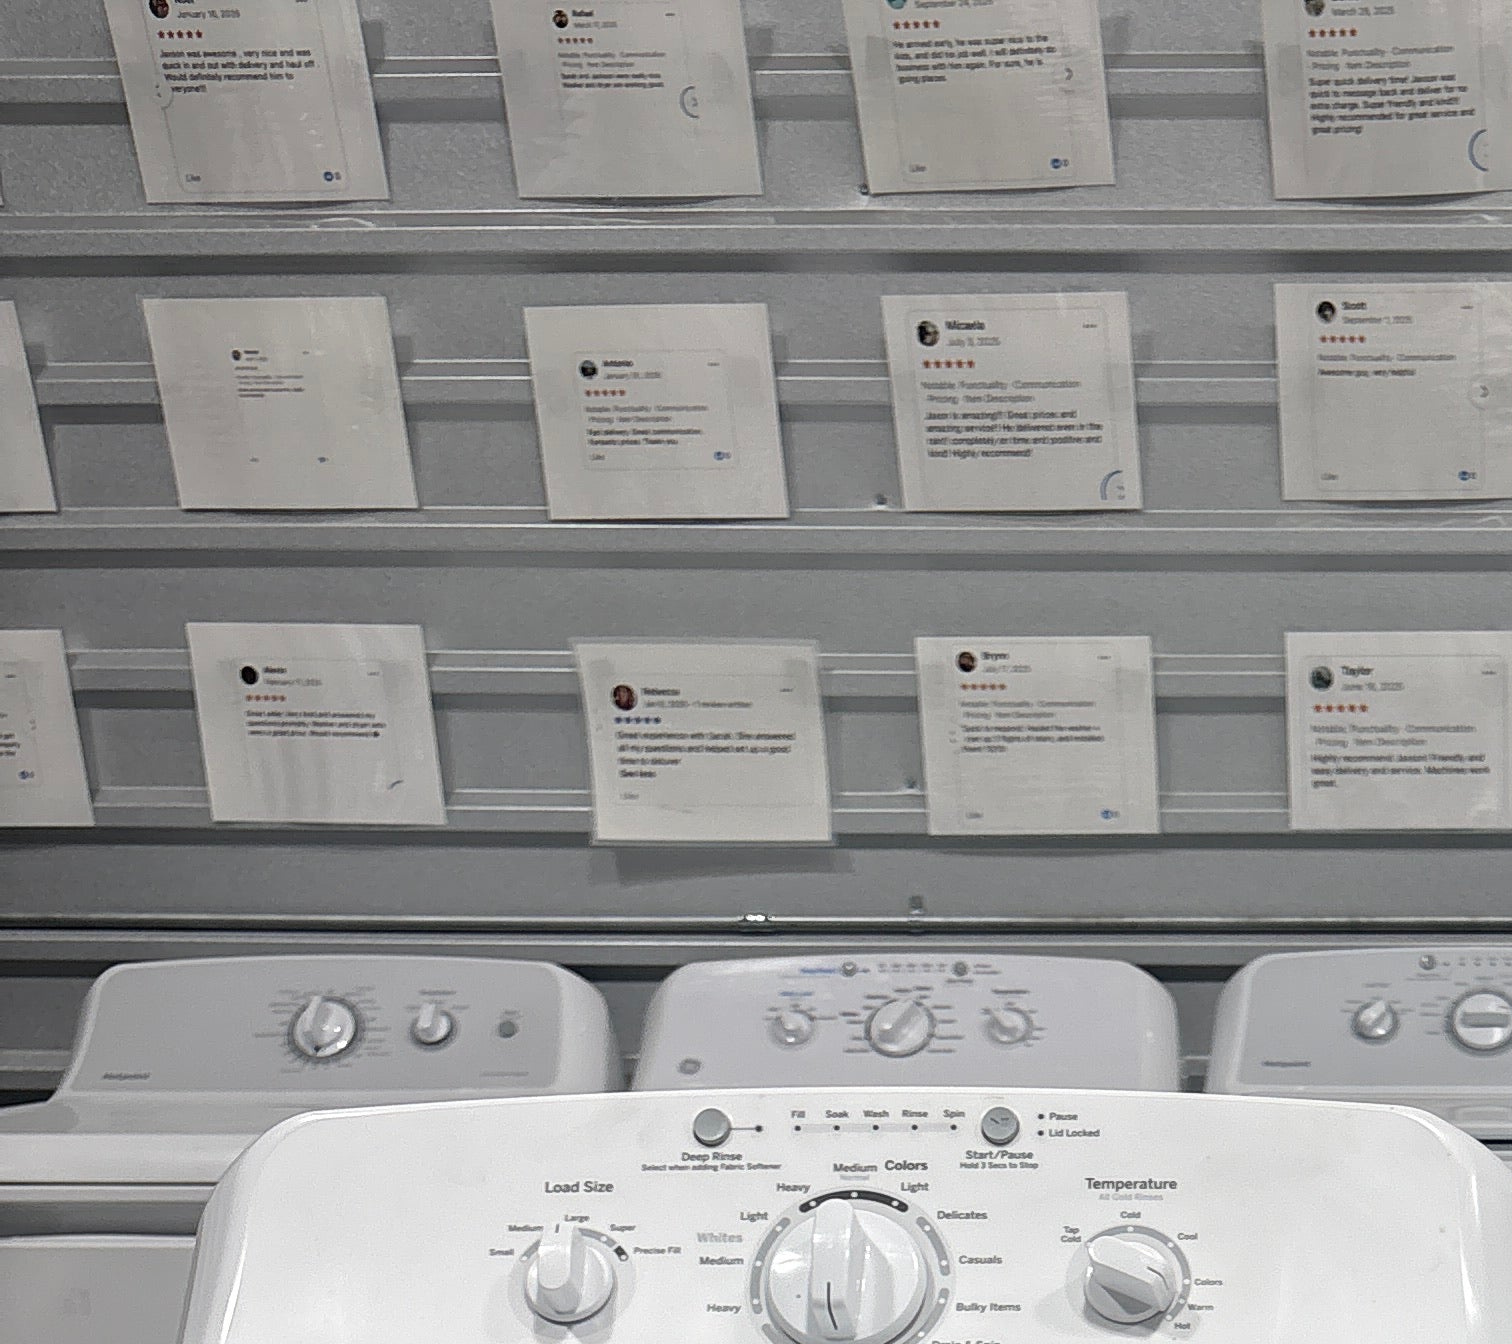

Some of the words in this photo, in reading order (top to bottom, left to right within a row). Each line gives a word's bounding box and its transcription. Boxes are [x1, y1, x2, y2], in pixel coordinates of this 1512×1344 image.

[790, 1110, 806, 1119] Fill
[826, 1110, 849, 1119] Soak
[863, 1110, 889, 1119] Wash
[902, 1109, 928, 1118] Rinse
[943, 1109, 965, 1119] Spin
[1049, 1112, 1078, 1121] Pause
[1049, 1129, 1063, 1138] Lid
[1066, 1129, 1101, 1138] Locked
[681, 1152, 710, 1163] Deep
[712, 1152, 742, 1162] Rinse
[966, 1150, 1033, 1160] Start/Pause
[692, 1164, 719, 1172] adding
[747, 1162, 782, 1170] Softener
[833, 1163, 878, 1173] Medium
[884, 1160, 928, 1171] Colors
[545, 1181, 580, 1193] Load
[583, 1181, 615, 1193] Size
[776, 1183, 811, 1194] Heavy
[901, 1182, 929, 1193] Light
[1085, 1177, 1178, 1192] Temperature
[564, 1213, 590, 1223] Large
[740, 1212, 769, 1223] Light
[937, 1210, 988, 1220] Delicates
[1120, 1211, 1141, 1219] Cold
[507, 1224, 544, 1232] Medium
[610, 1224, 636, 1233] Super
[1063, 1226, 1080, 1235] Tap
[697, 1232, 744, 1243] Whites
[1061, 1235, 1082, 1243] Cold
[1177, 1232, 1198, 1241] Cool
[489, 1248, 514, 1257] Small
[633, 1246, 666, 1254] Precise
[667, 1245, 682, 1254] Fill
[700, 1256, 744, 1265] Medium
[959, 1255, 1003, 1265] Casuals
[1194, 1278, 1223, 1286] Colors
[707, 1303, 742, 1314] Heavy
[956, 1303, 987, 1313] Bulky
[989, 1303, 1022, 1312] Items
[1187, 1303, 1214, 1312] Warm
[1174, 1322, 1191, 1330] Hot
